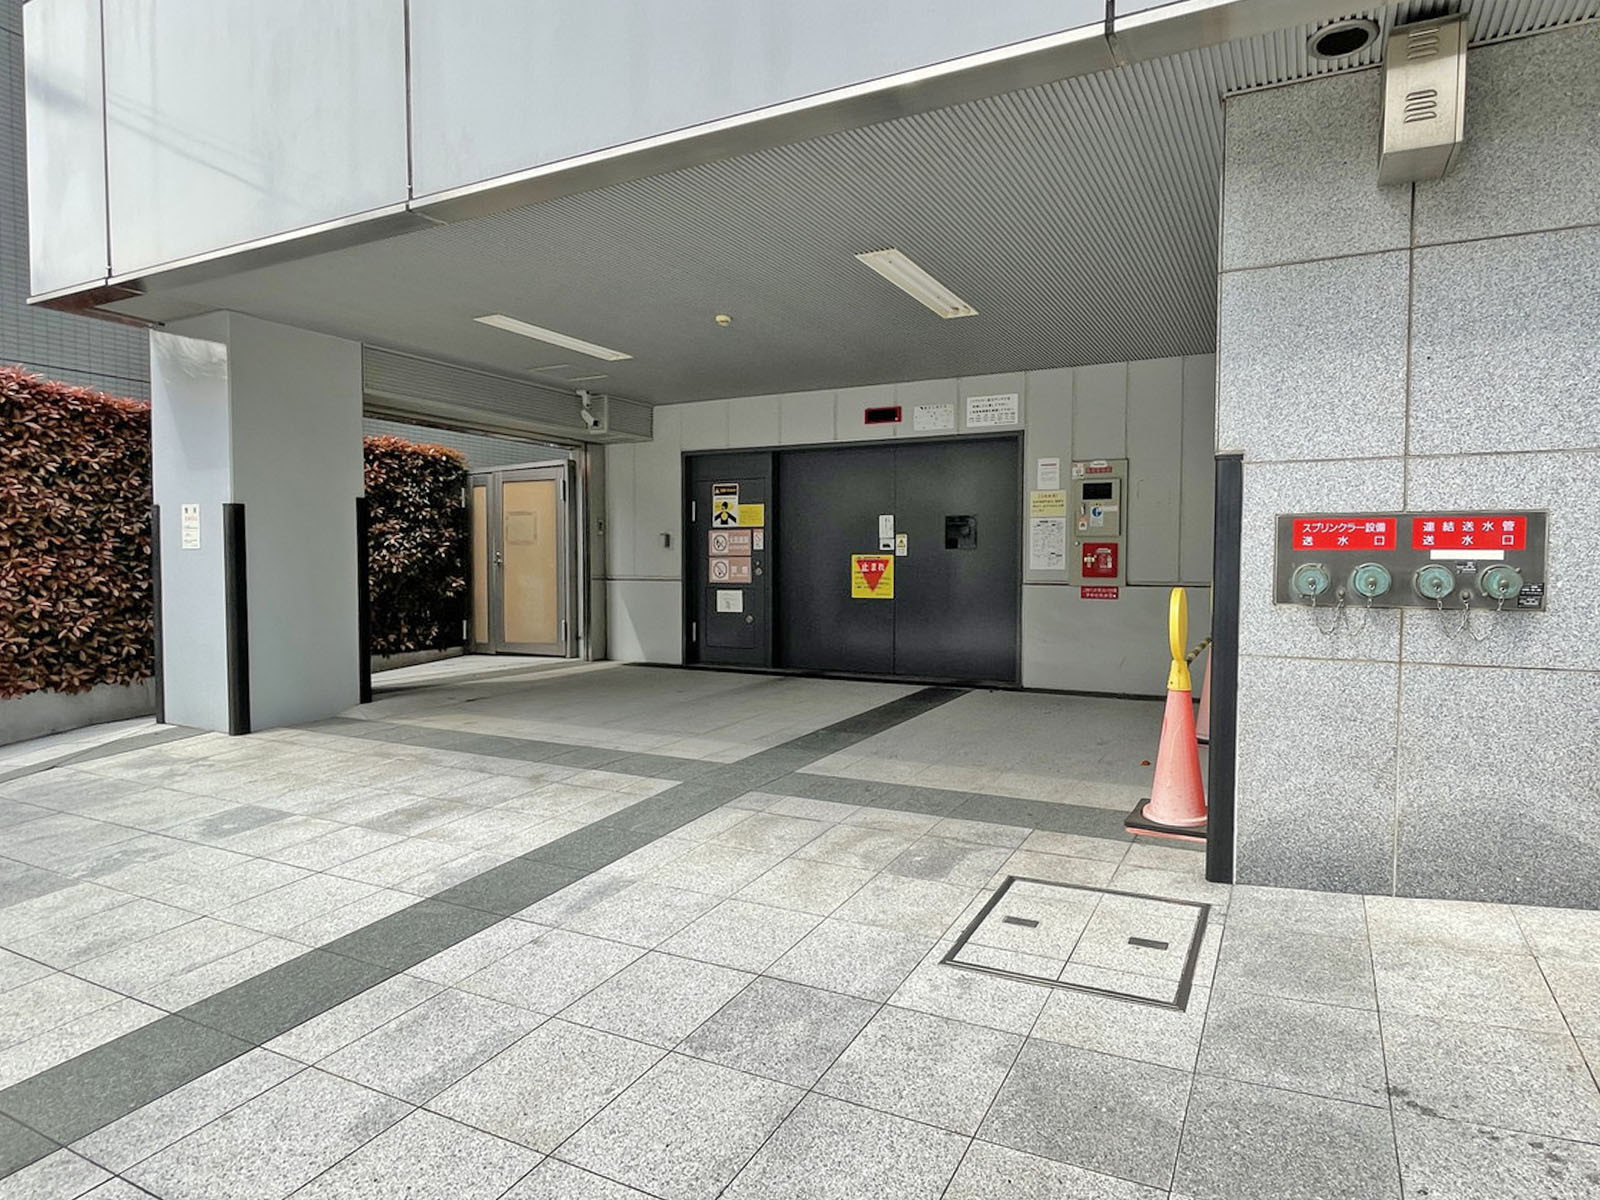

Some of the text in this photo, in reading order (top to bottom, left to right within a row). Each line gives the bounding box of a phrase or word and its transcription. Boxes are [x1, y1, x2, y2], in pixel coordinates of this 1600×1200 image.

[1302, 522, 1386, 533] スプリンクラー設備
[1422, 520, 1515, 532] 連結送水管
[1302, 536, 1385, 546] 送水口
[1422, 535, 1515, 545] 送水口
